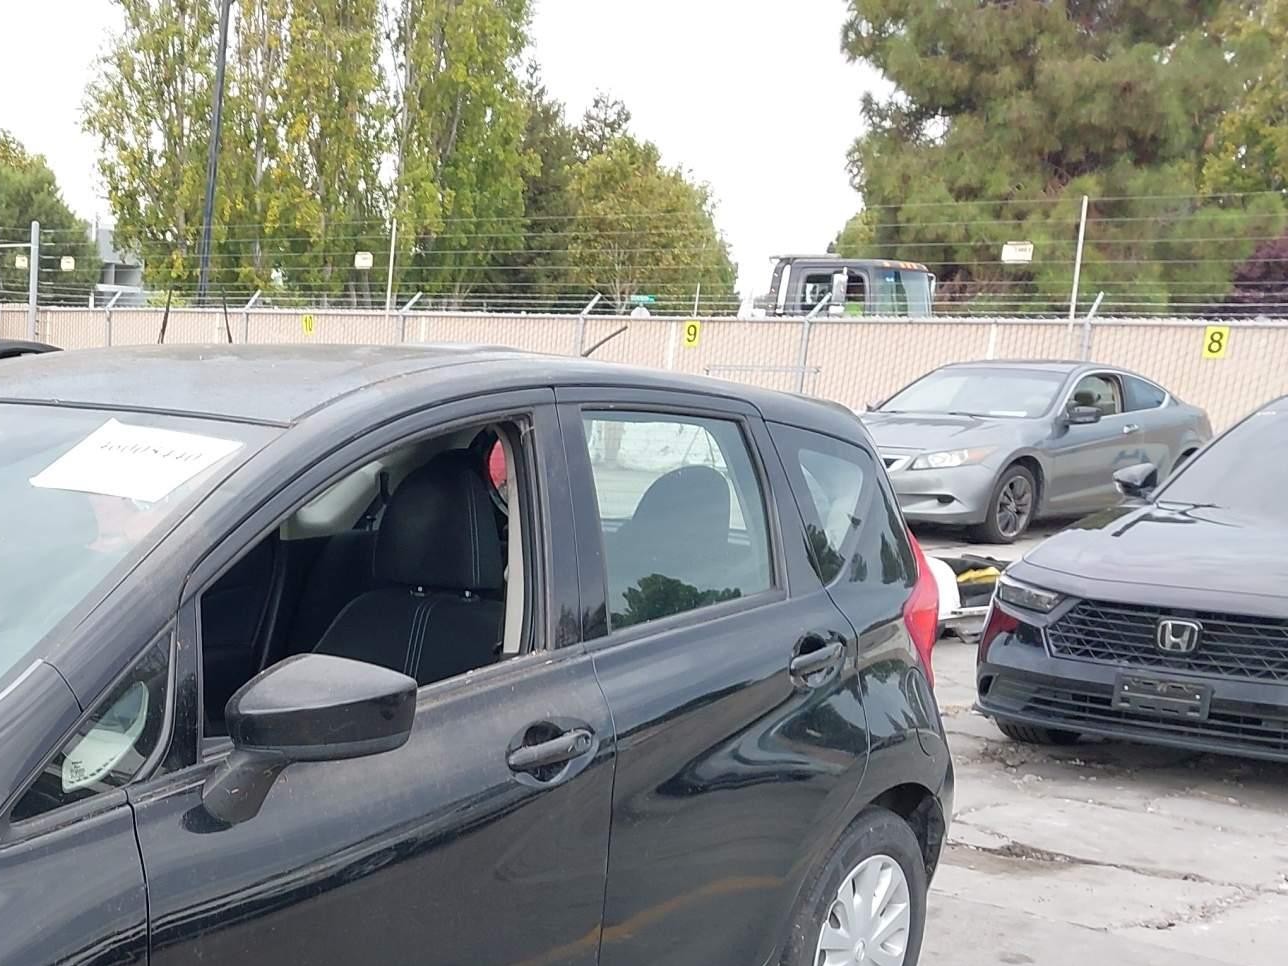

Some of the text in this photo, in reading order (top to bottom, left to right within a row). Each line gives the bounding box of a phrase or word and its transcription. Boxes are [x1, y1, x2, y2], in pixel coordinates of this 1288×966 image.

[304, 316, 313, 332] 10
[687, 324, 697, 342] 9
[1207, 331, 1224, 353] 8
